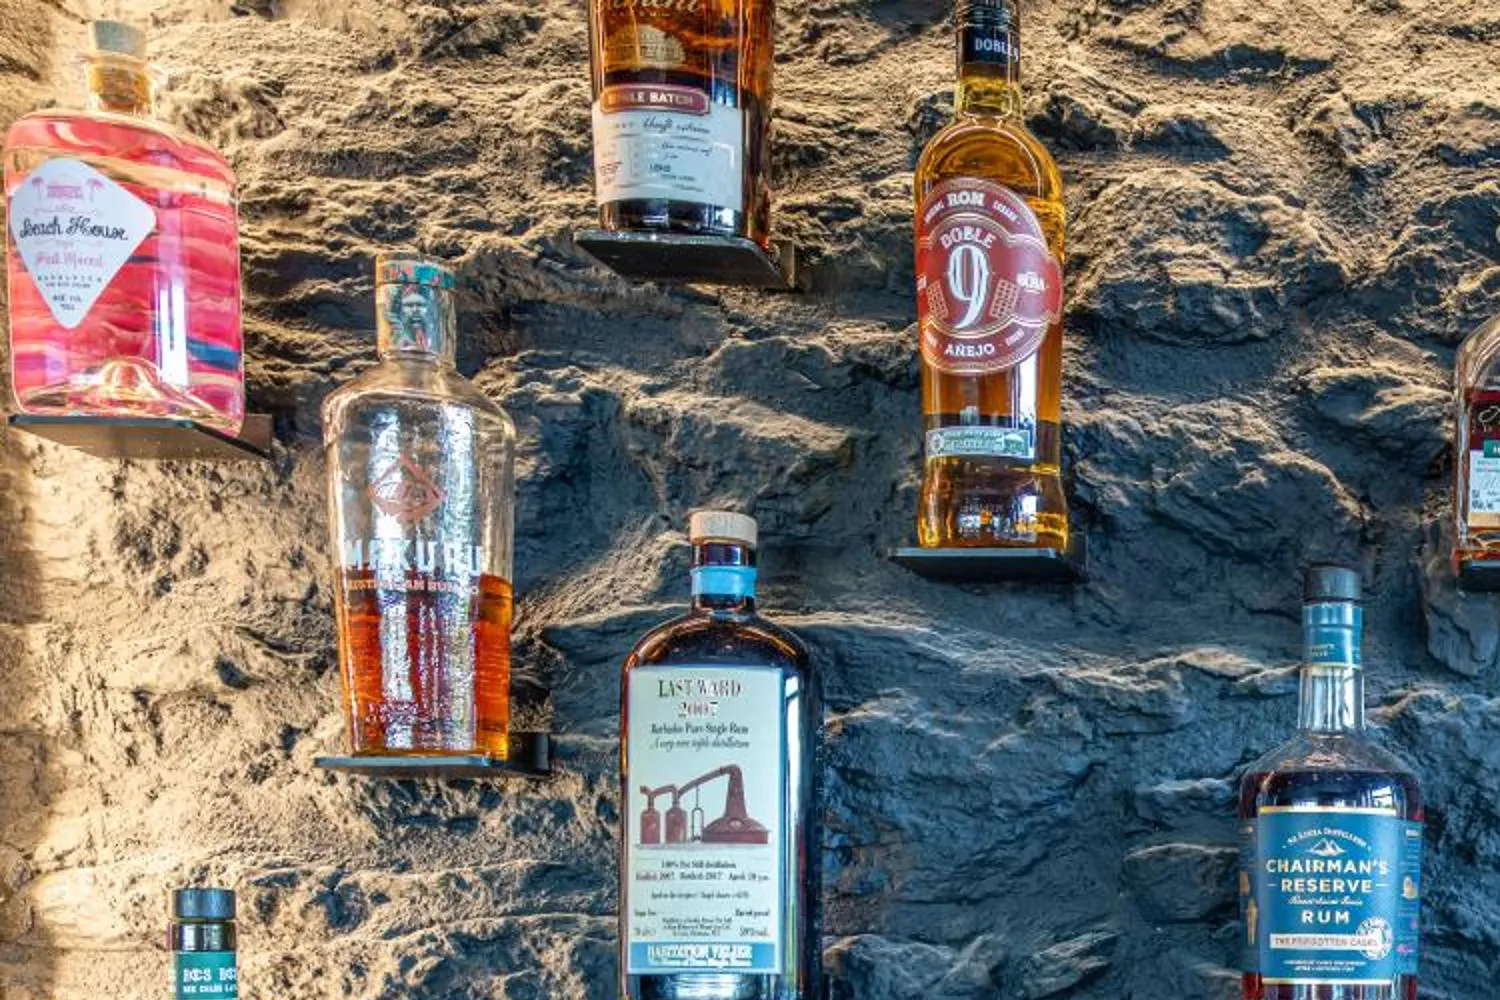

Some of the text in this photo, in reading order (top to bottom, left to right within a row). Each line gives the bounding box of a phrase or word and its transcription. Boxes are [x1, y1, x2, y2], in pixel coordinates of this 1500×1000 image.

[649, 91, 694, 106] BATCH
[947, 190, 986, 206] RON
[939, 226, 997, 249] DOBLE
[948, 243, 990, 329] 9
[943, 342, 996, 358] AÑEJO
[658, 679, 742, 698] LAST WARD
[677, 701, 719, 718] 2007
[1265, 858, 1390, 875] CHAIRMAN'S
[1280, 878, 1373, 894] RESERVE
[1301, 910, 1350, 925] RUM
